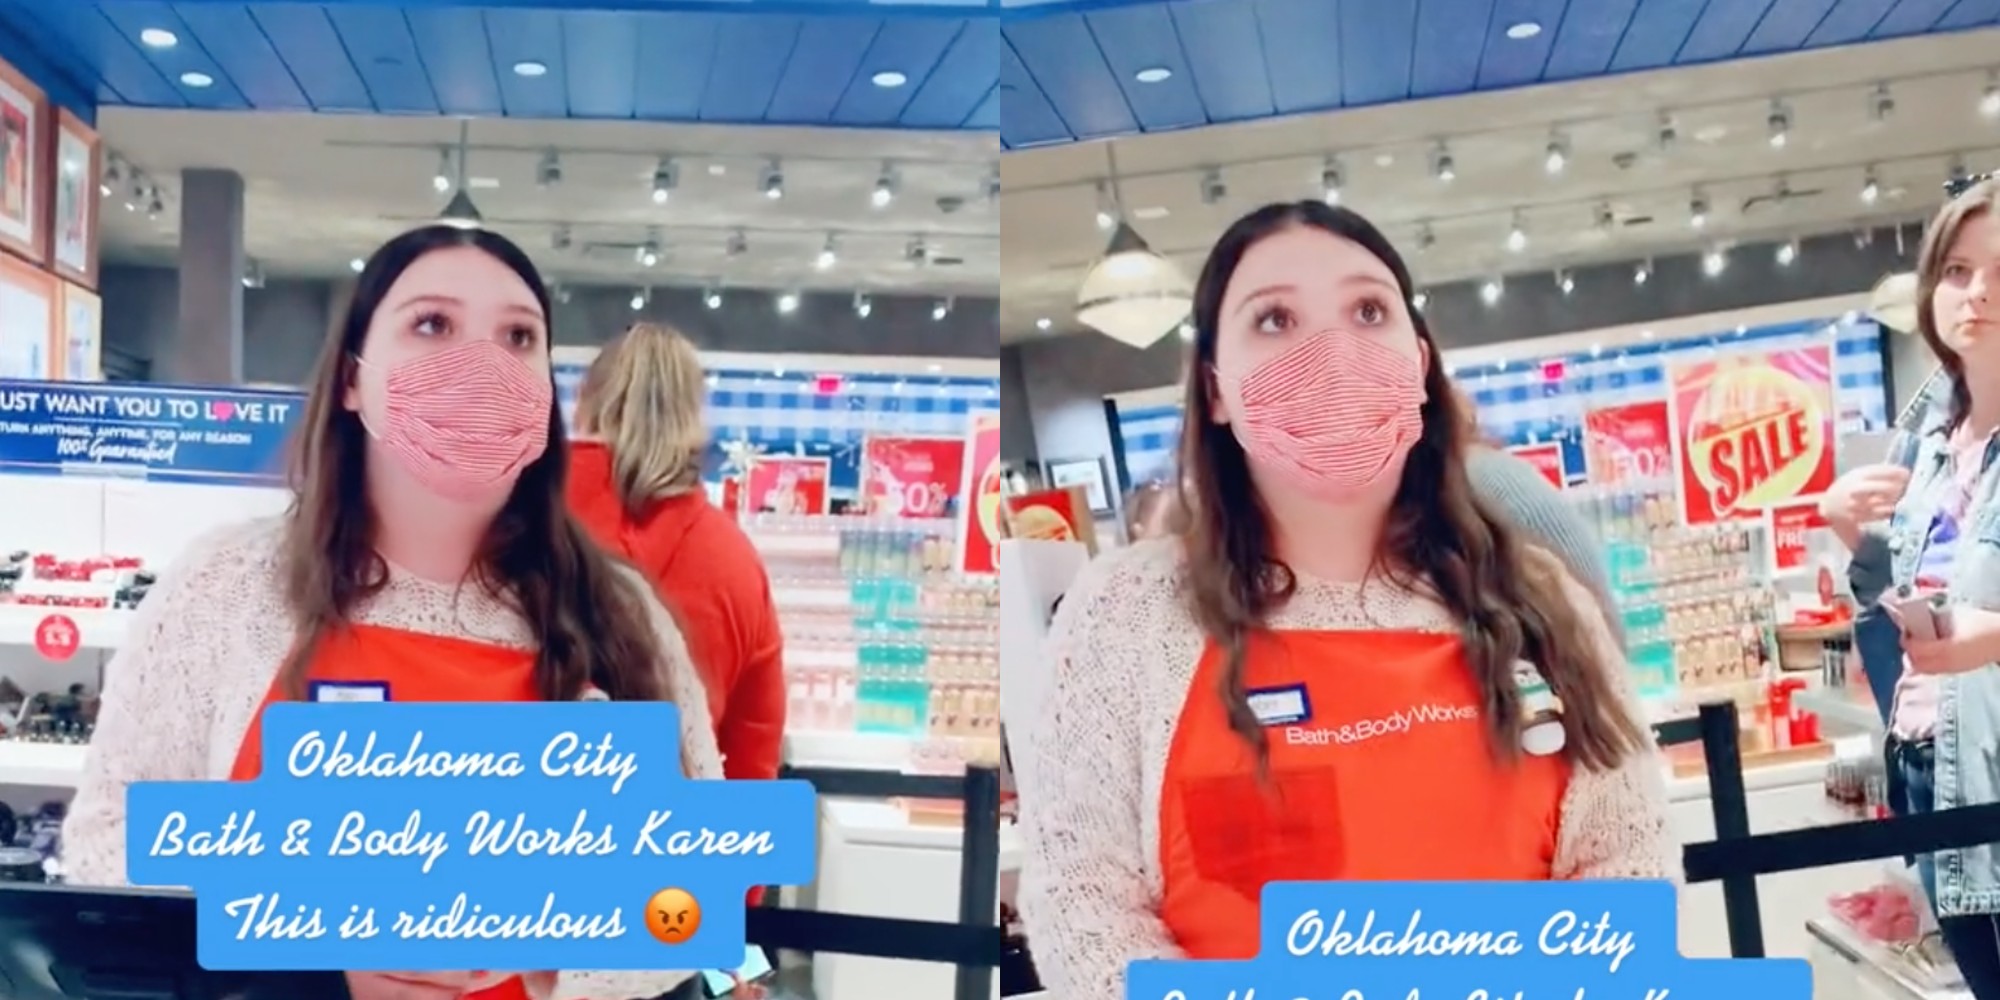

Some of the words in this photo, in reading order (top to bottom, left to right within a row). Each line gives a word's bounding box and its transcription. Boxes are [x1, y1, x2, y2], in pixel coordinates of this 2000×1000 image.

[44, 393, 109, 414] WANT
[114, 396, 161, 417] YOU
[166, 398, 199, 419] TO
[268, 403, 290, 424] IT
[153, 429, 176, 441] FOR
[179, 431, 202, 442] ANY
[205, 432, 252, 445] REASON
[1710, 410, 1808, 509] SALE
